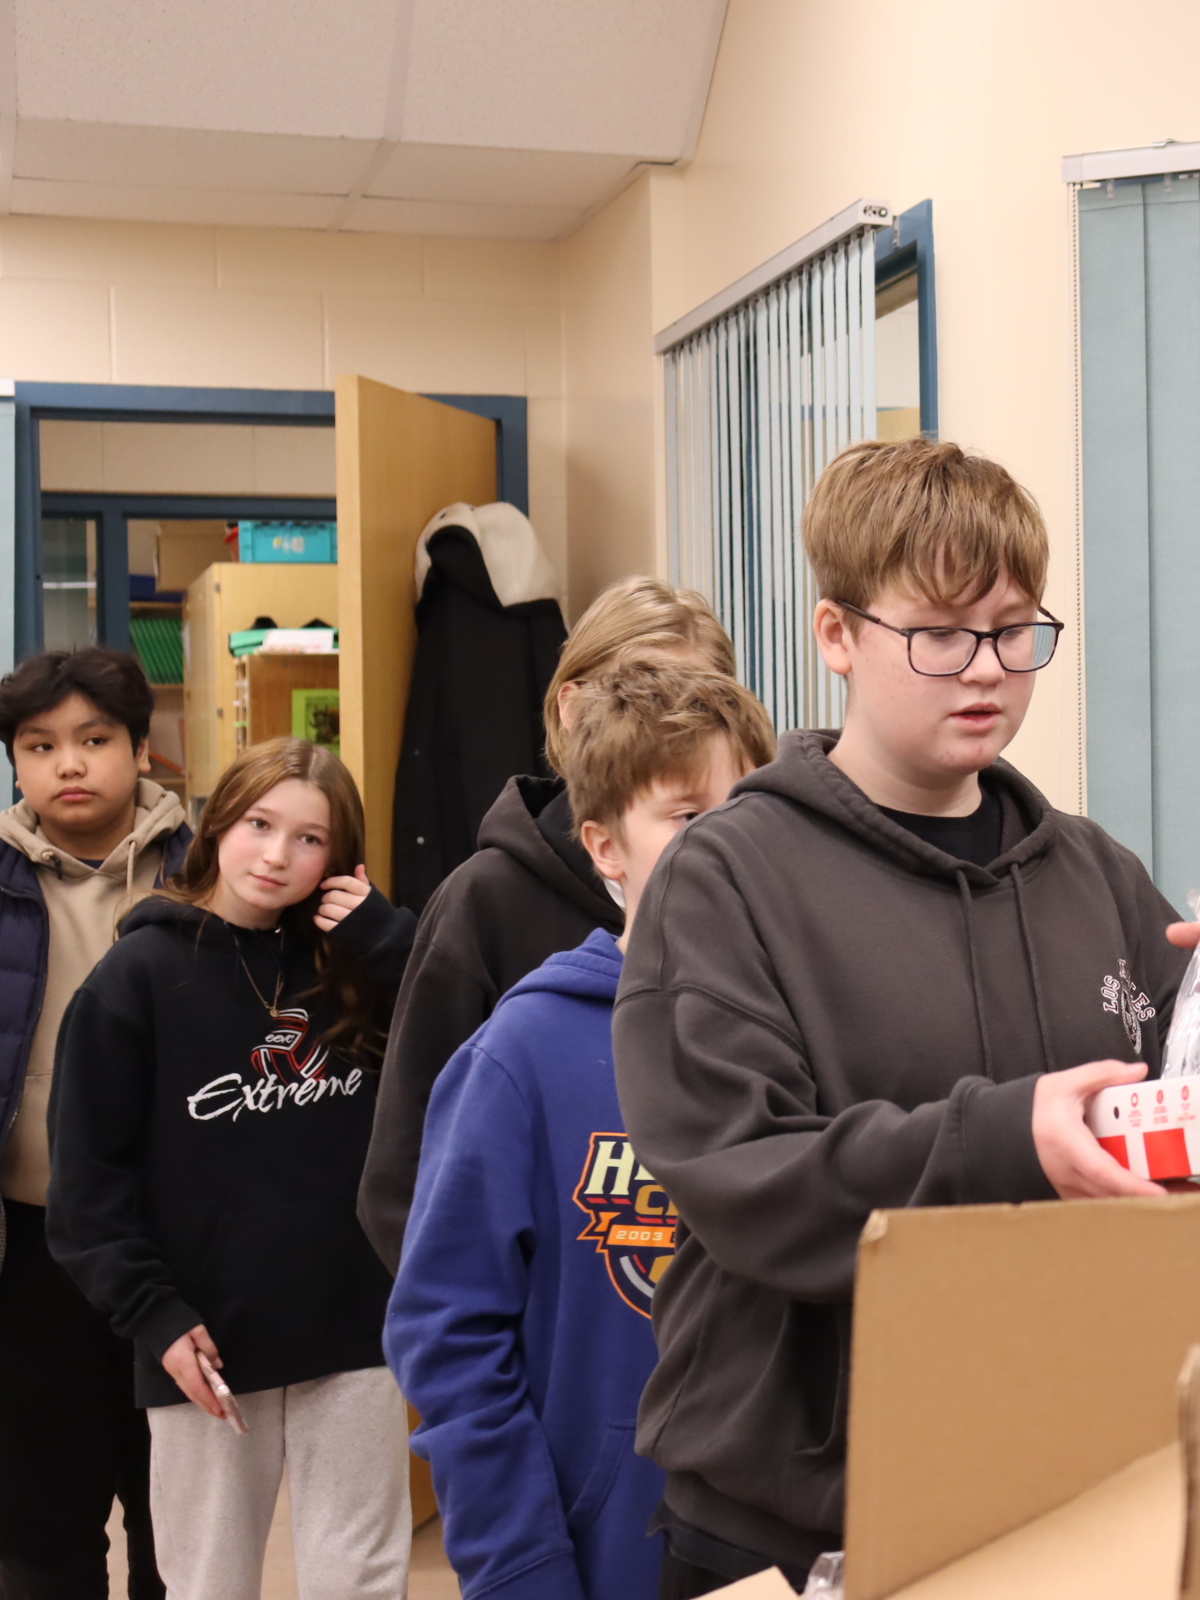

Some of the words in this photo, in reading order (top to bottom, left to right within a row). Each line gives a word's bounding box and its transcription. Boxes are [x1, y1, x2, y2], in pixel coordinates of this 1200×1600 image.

[1101, 975, 1120, 1014] LOS
[187, 1068, 362, 1122] Extreme
[616, 1230, 664, 1241] 2003
